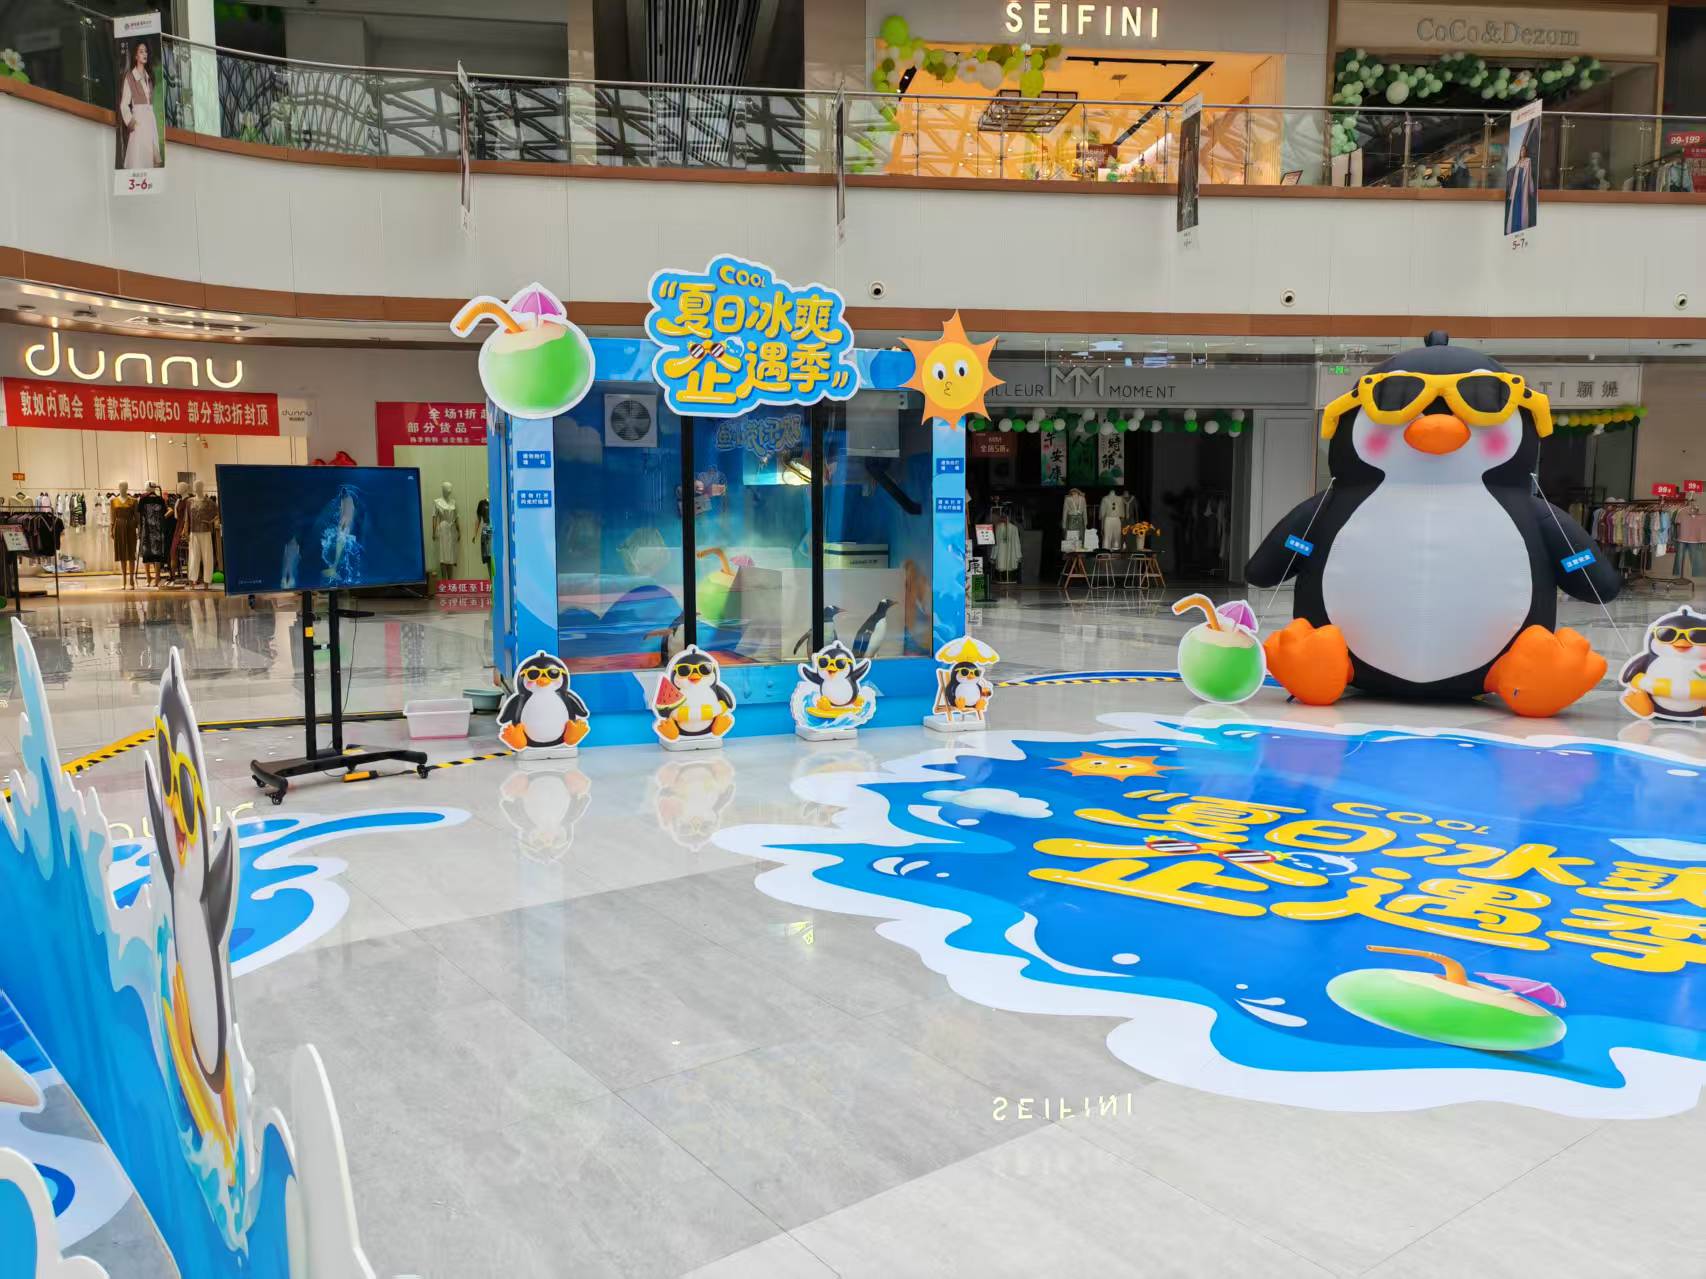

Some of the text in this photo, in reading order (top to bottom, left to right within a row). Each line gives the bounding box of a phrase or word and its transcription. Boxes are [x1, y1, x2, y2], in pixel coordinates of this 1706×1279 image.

[1005, 3, 1158, 38] SEIFINI
[719, 265, 766, 288] COOL
[25, 332, 243, 388] dunnu
[19, 390, 269, 426] 敦奴内购会 新款满500减50 部分款3折封顶
[1109, 385, 1176, 398] MOMENT
[1331, 801, 1492, 836] COOL
